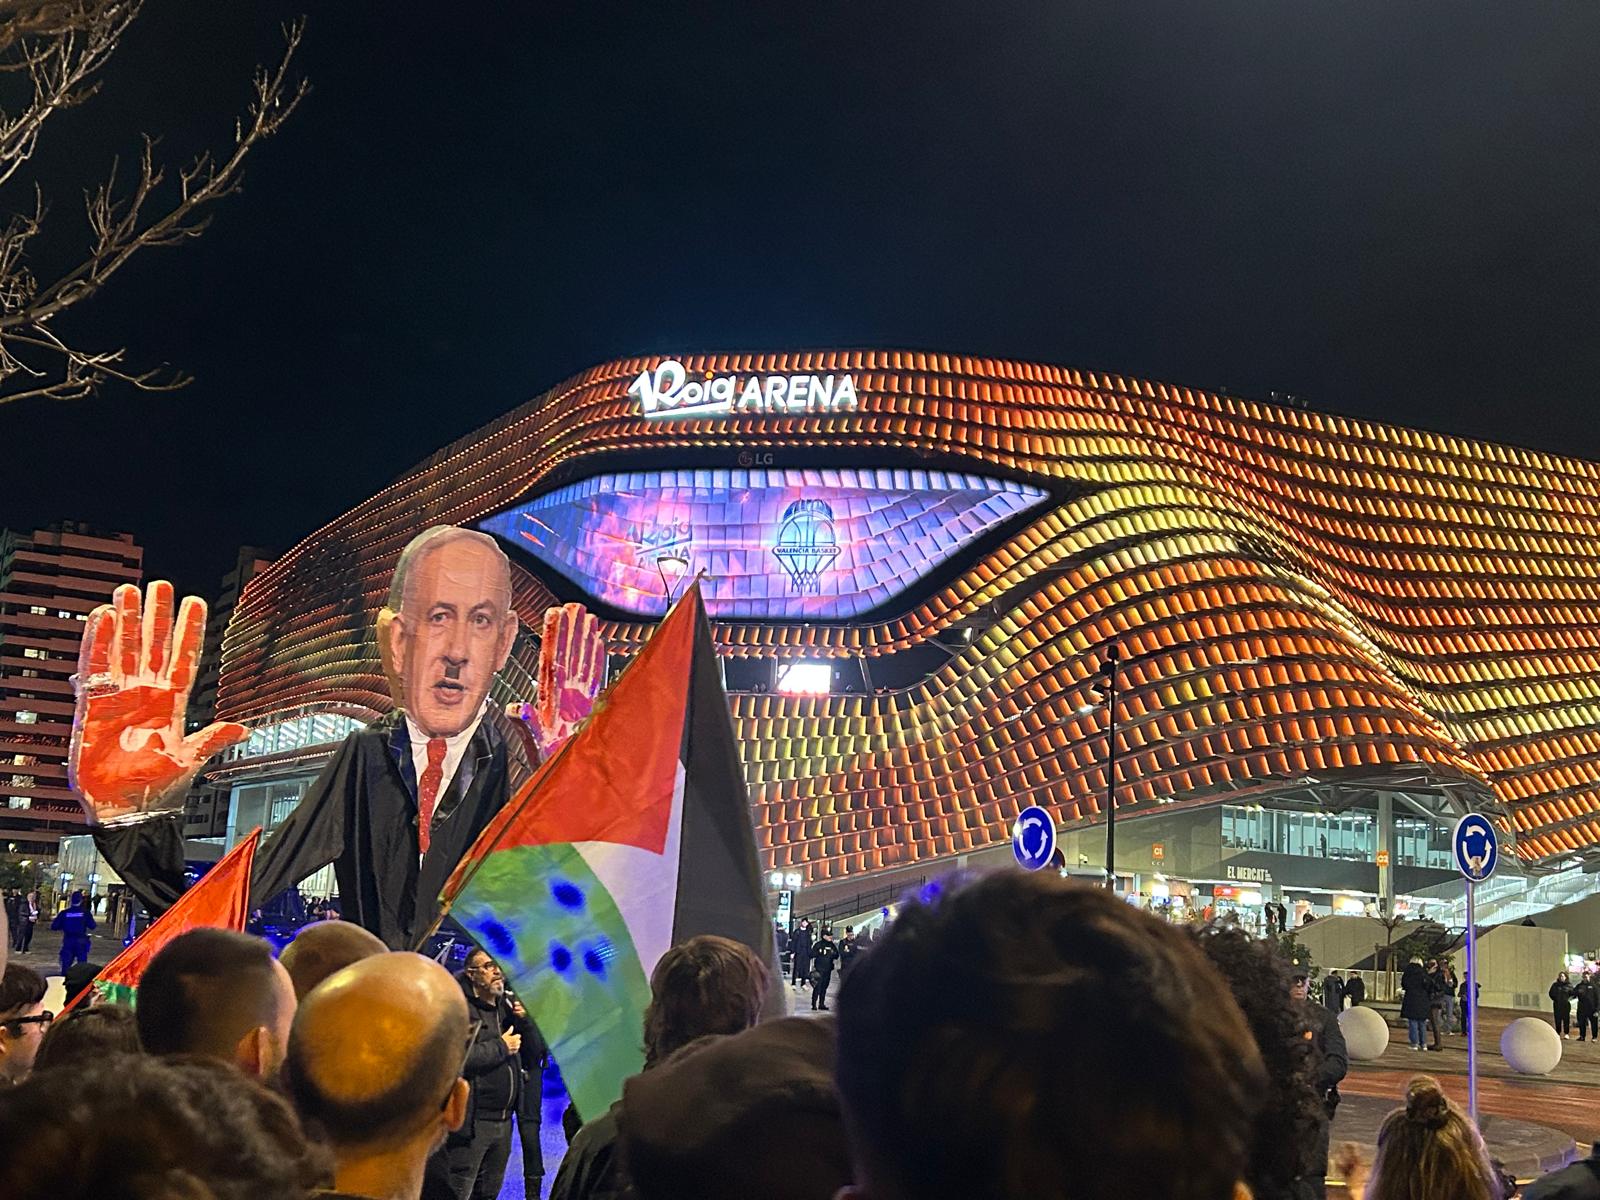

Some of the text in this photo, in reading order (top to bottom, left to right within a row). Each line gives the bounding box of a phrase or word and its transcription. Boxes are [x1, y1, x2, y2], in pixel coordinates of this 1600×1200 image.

[628, 360, 858, 417] Roig ARENA
[755, 453, 773, 465] LG
[1227, 865, 1236, 879] EL
[1236, 866, 1265, 881] MERCAT
